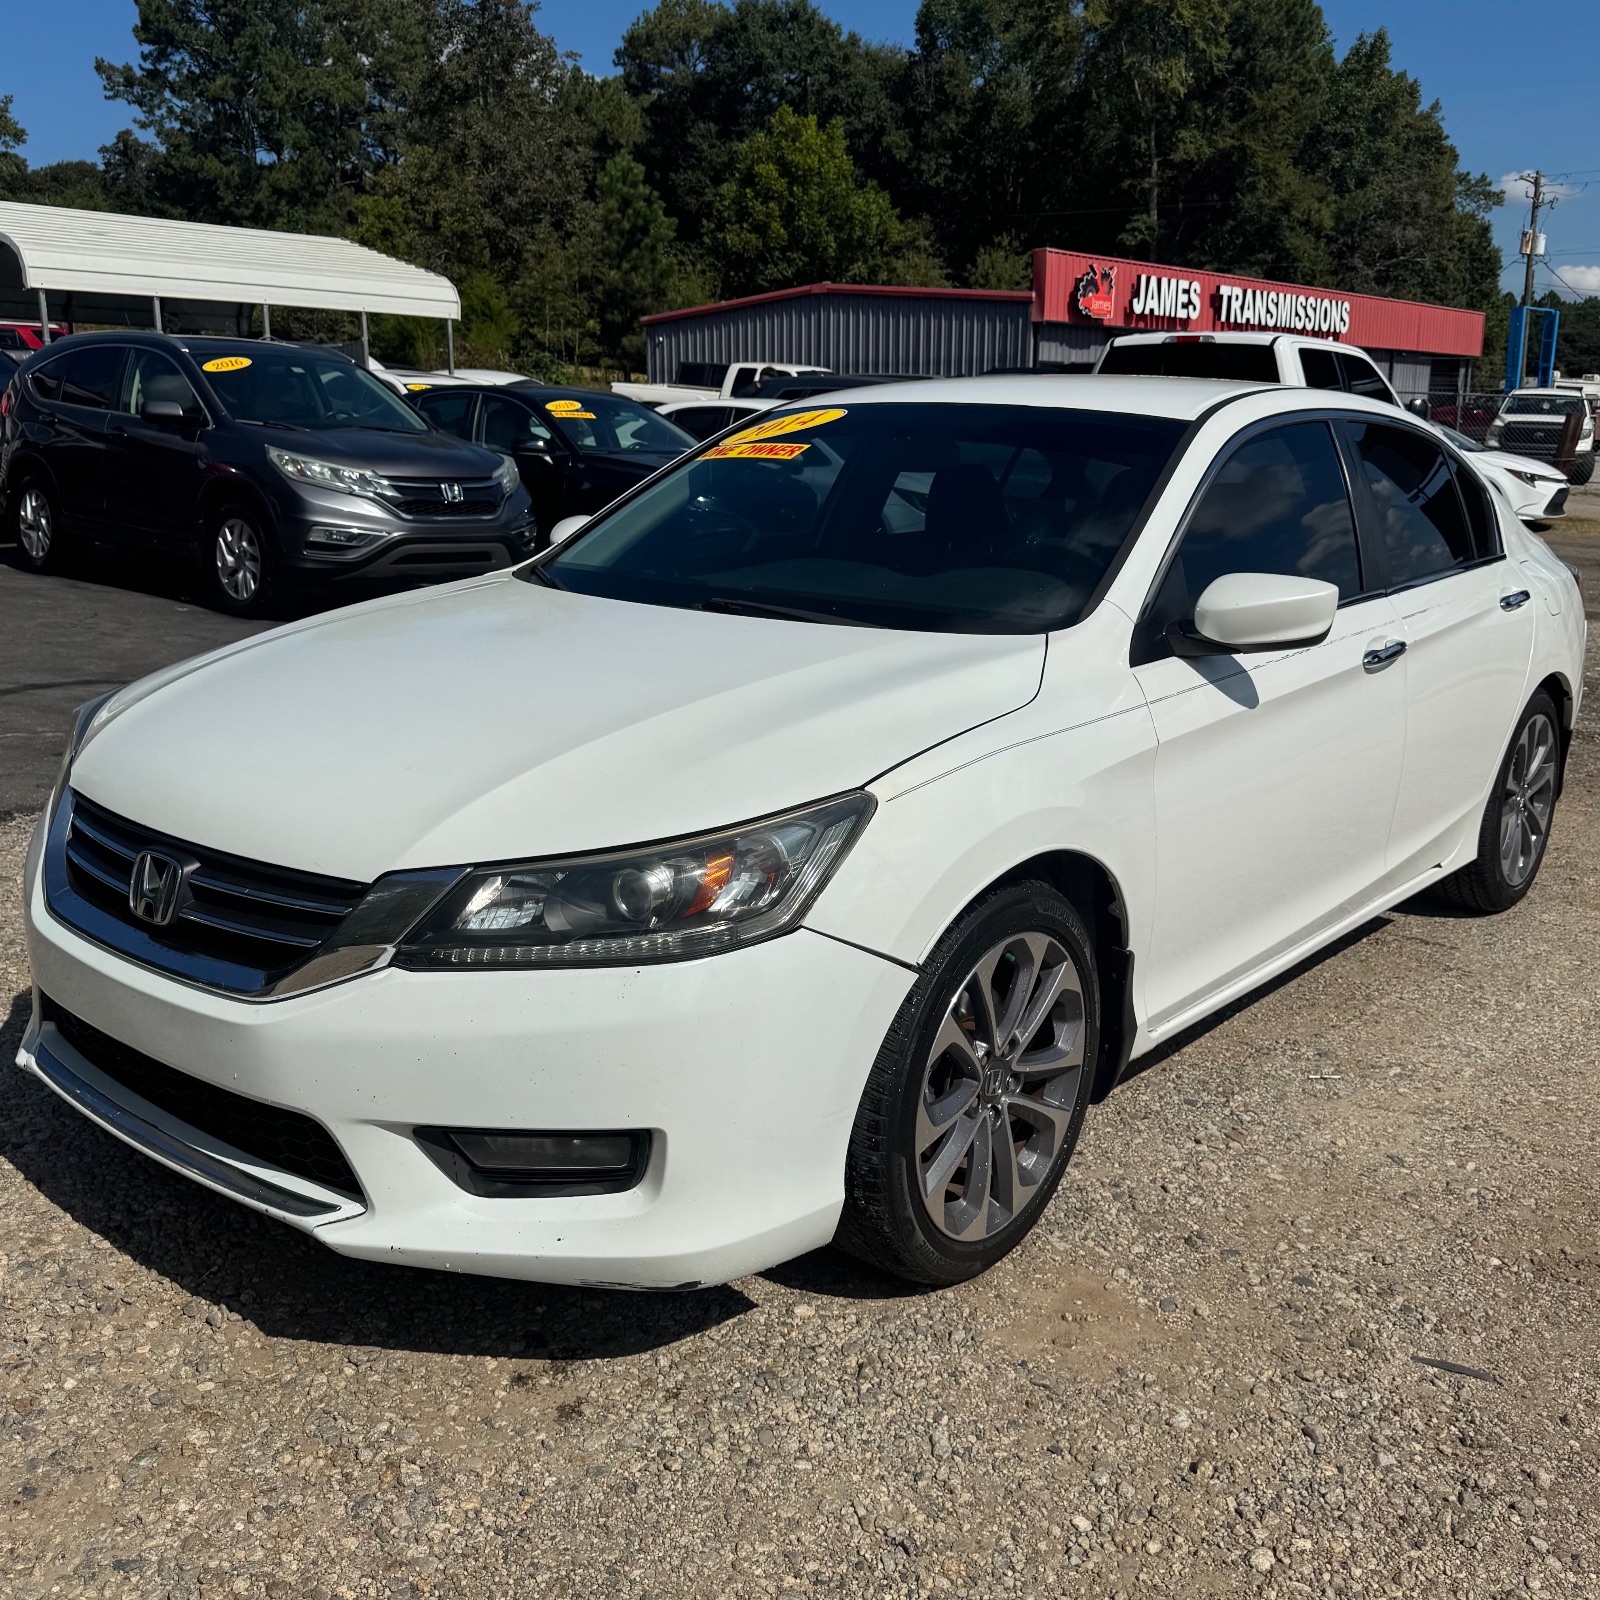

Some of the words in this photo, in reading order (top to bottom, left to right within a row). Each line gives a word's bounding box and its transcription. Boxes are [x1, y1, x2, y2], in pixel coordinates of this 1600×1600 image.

[1092, 298, 1111, 311] James
[1132, 274, 1200, 320] JAMES
[1219, 284, 1350, 334] TRANSMISSIONS
[212, 358, 244, 370] 2016
[733, 410, 830, 442] 2014
[700, 445, 737, 459] ONE
[737, 444, 805, 458] OWNER
